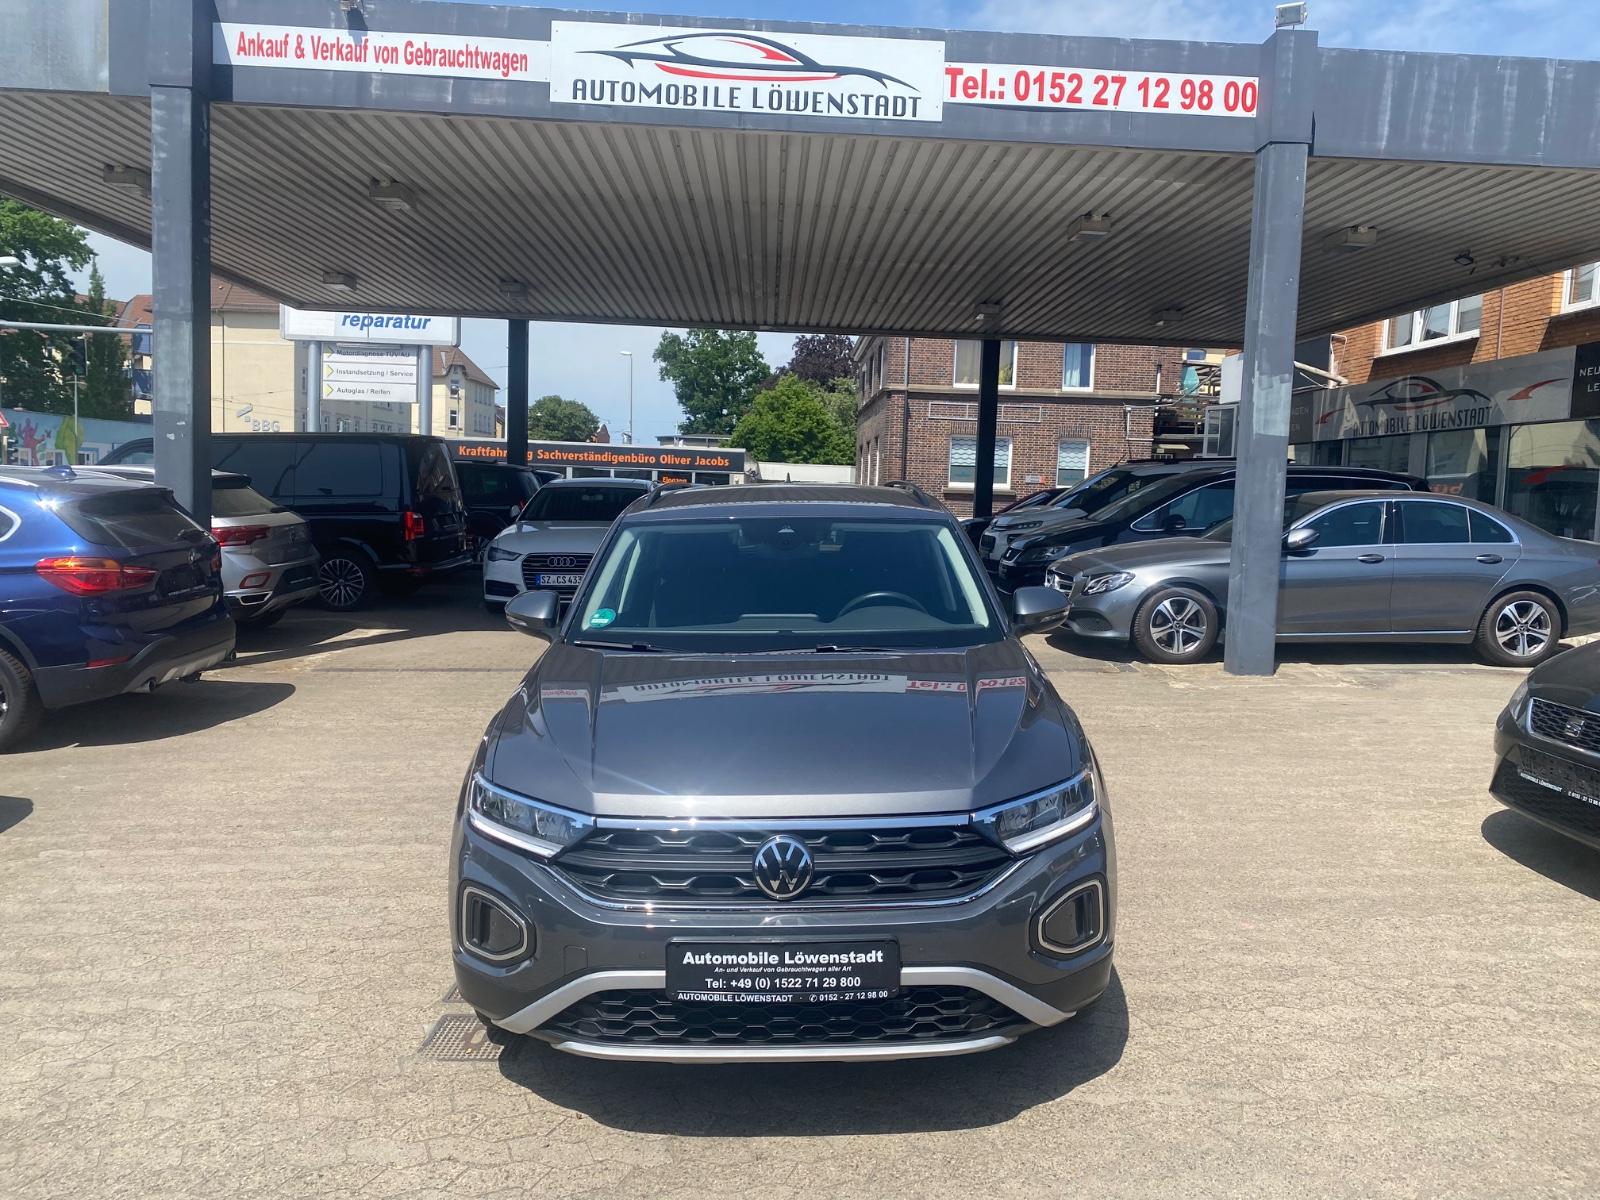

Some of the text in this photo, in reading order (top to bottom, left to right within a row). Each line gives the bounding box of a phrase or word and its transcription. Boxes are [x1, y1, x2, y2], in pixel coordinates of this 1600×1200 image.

[236, 31, 528, 77] Ankauf & Verkauf von Gebrauchtwagen
[945, 67, 1257, 112] Tel.: 0152 27 12 98 00
[572, 78, 922, 118] AUTOMOBILE LÖWENSTADT
[341, 313, 431, 330] reparatur
[336, 368, 385, 377] Instandsetzung
[1416, 405, 1493, 431] LÖWENSTADT
[537, 449, 656, 464] Sachverständigenbüro
[660, 454, 691, 465] Oliver
[695, 456, 730, 467] Jacobs
[556, 575, 567, 585] CS
[682, 950, 883, 965] Automobile Löwenstadt
[776, 966, 826, 974] Gebrauchtwagen
[705, 976, 861, 990] Tel: +49 (0) 1522 71 29 800
[677, 992, 733, 1002] AUTOMOBILE
[735, 992, 793, 1003] LÖWENSTADT
[819, 992, 838, 1002] 0152
[845, 992, 855, 1001] 27
[856, 992, 866, 1000] 12
[867, 991, 877, 1000] 98
[878, 991, 888, 999] 00
